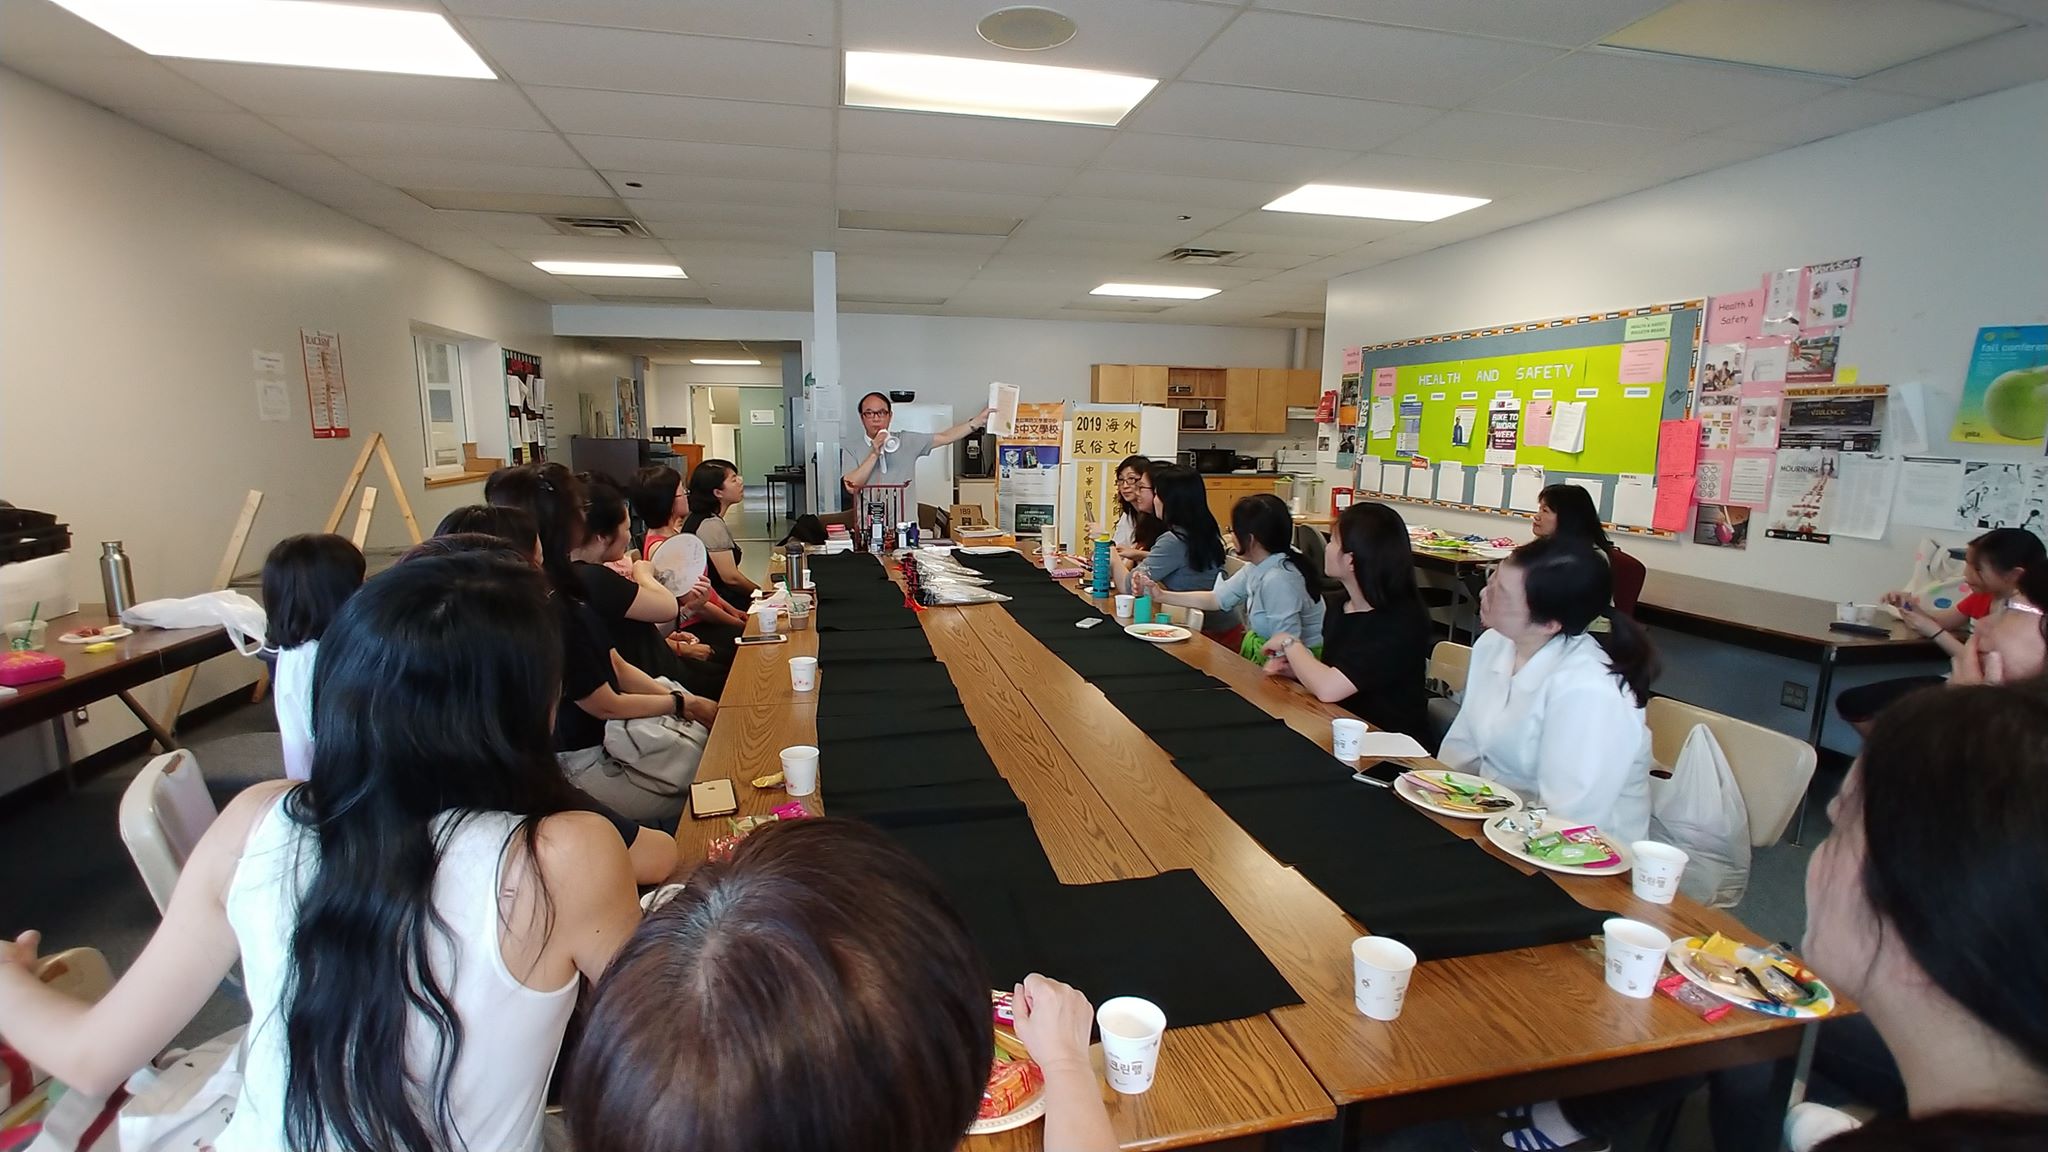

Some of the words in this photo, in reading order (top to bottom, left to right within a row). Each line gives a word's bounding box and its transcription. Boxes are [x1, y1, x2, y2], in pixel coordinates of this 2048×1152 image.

[1718, 301, 1746, 310] Health
[1720, 315, 1748, 325] Safety
[1981, 343, 1999, 352] fall
[1418, 373, 1460, 386] HEALTH
[1476, 369, 1499, 382] AND
[1515, 364, 1574, 380] SAFETY
[1492, 413, 1509, 421] BIKE
[1509, 413, 1519, 421] TO
[1076, 416, 1101, 431] 2019
[1105, 417, 1137, 433] 海外
[1496, 422, 1517, 430] WORK
[1495, 430, 1516, 438] WEEK
[1073, 440, 1138, 454] 民俗文化
[1780, 465, 1818, 473] MOURNING
